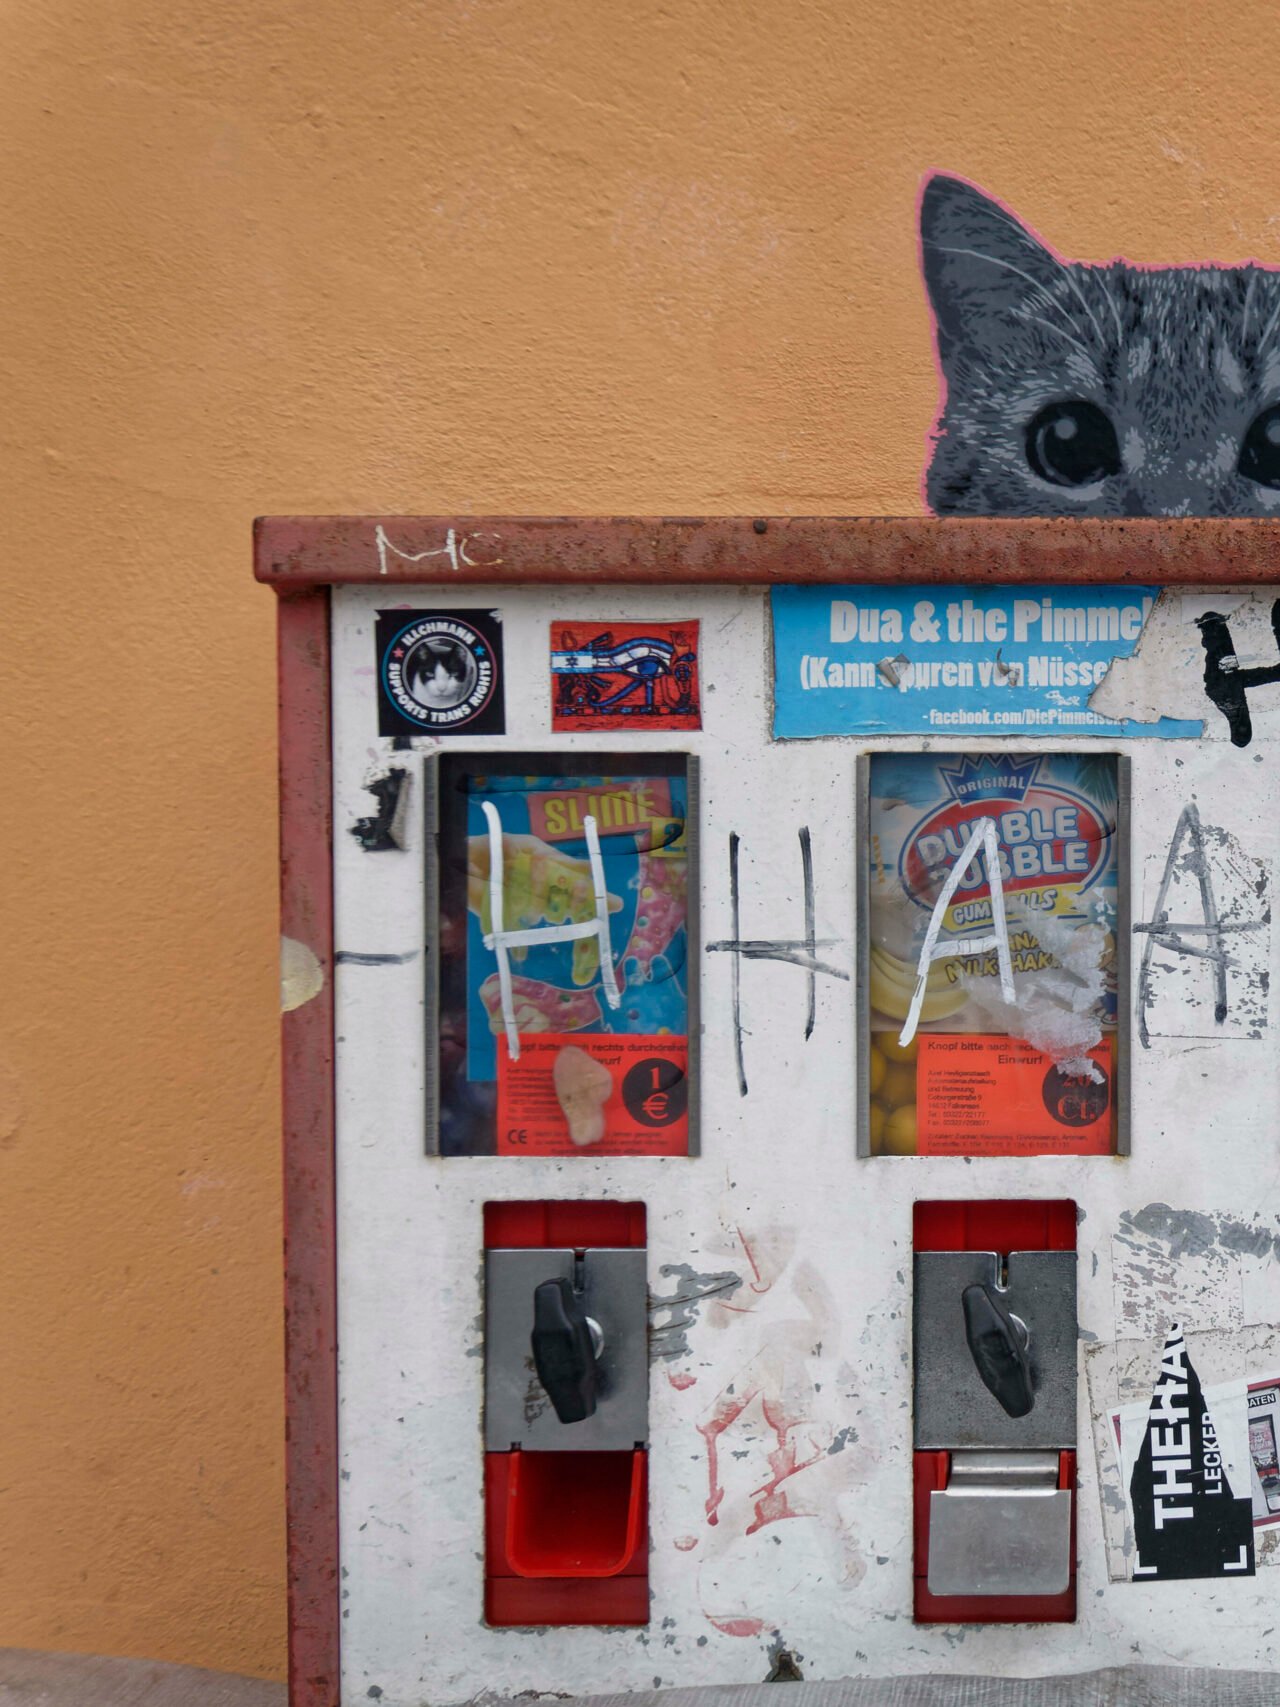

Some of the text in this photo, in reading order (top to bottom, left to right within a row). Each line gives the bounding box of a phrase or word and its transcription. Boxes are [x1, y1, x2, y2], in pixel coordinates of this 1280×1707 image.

[830, 599, 903, 643] Dua
[909, 601, 941, 643] &
[946, 599, 1008, 642] the
[800, 655, 875, 689] (Kann
[388, 661, 491, 722] SUPPORTS TRANS RIGHTS
[958, 776, 1025, 795] ORIGINAL
[927, 1042, 958, 1052] Knopf
[960, 1041, 984, 1051] bitte
[650, 1067, 661, 1089] 1
